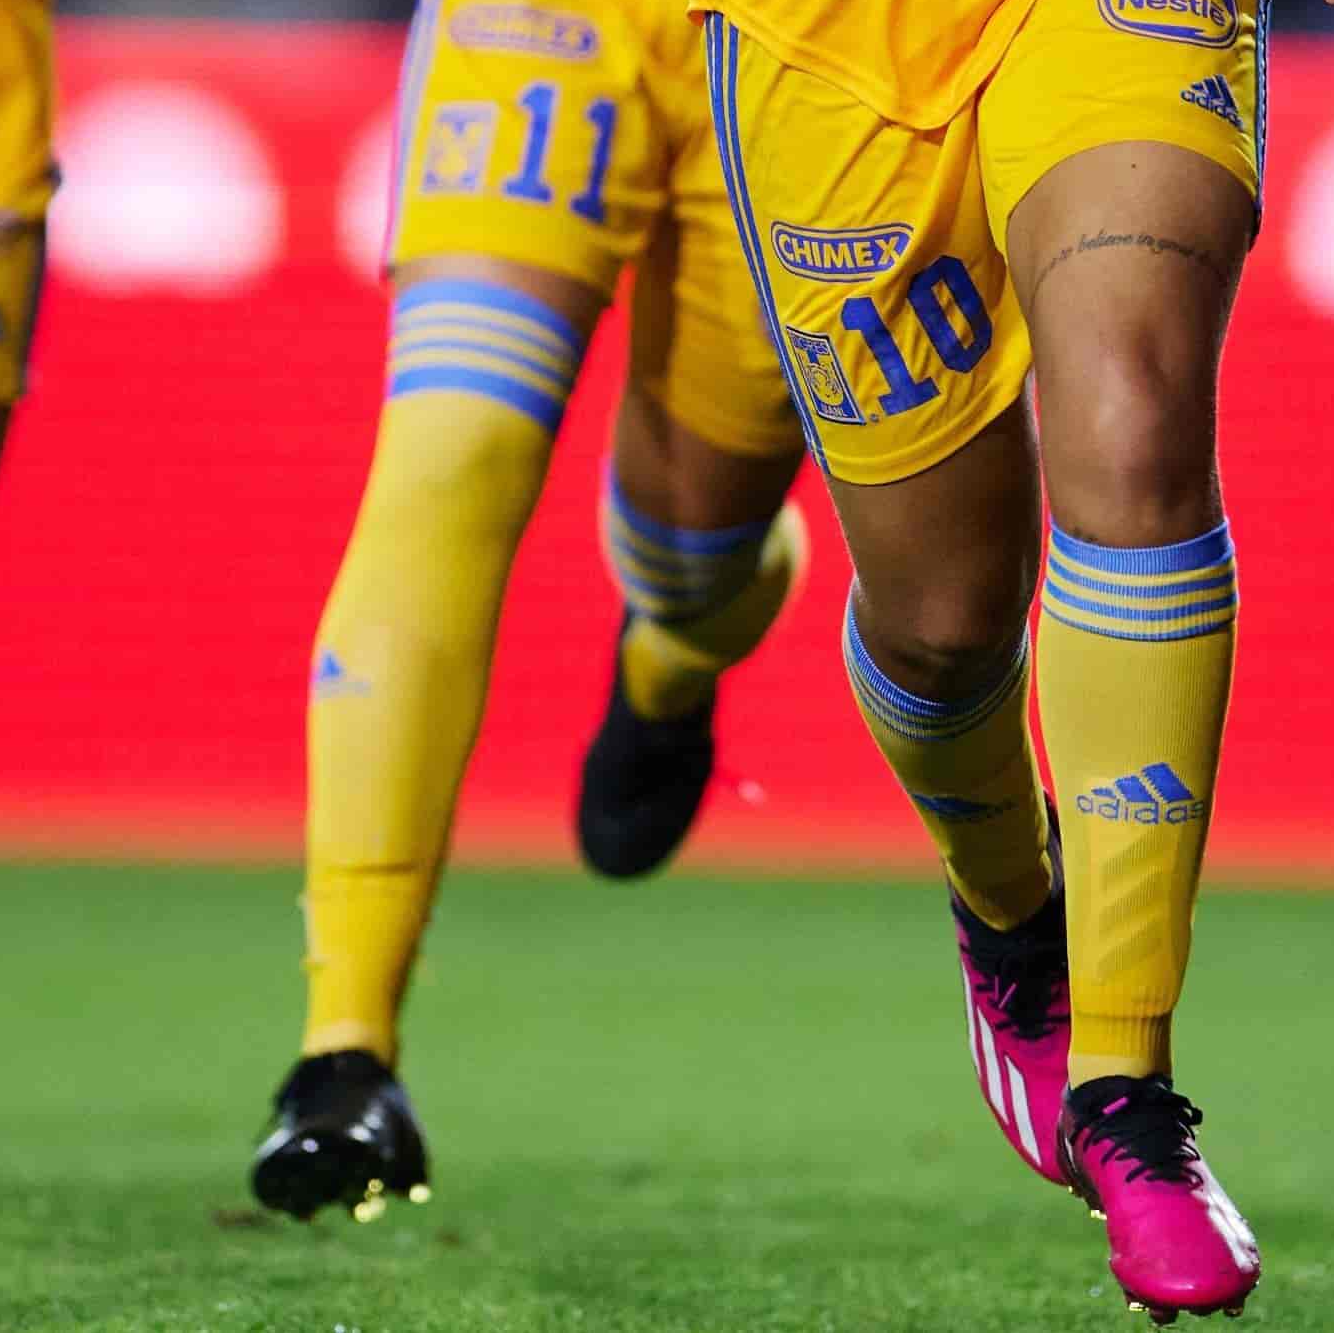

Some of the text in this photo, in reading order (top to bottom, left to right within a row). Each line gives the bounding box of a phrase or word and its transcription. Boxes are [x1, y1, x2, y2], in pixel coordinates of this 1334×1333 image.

[1180, 90, 1245, 132] adidas
[502, 78, 618, 226] 11
[778, 232, 902, 268] CHIMEX
[840, 255, 993, 417] 10
[1076, 791, 1205, 825] adidas
